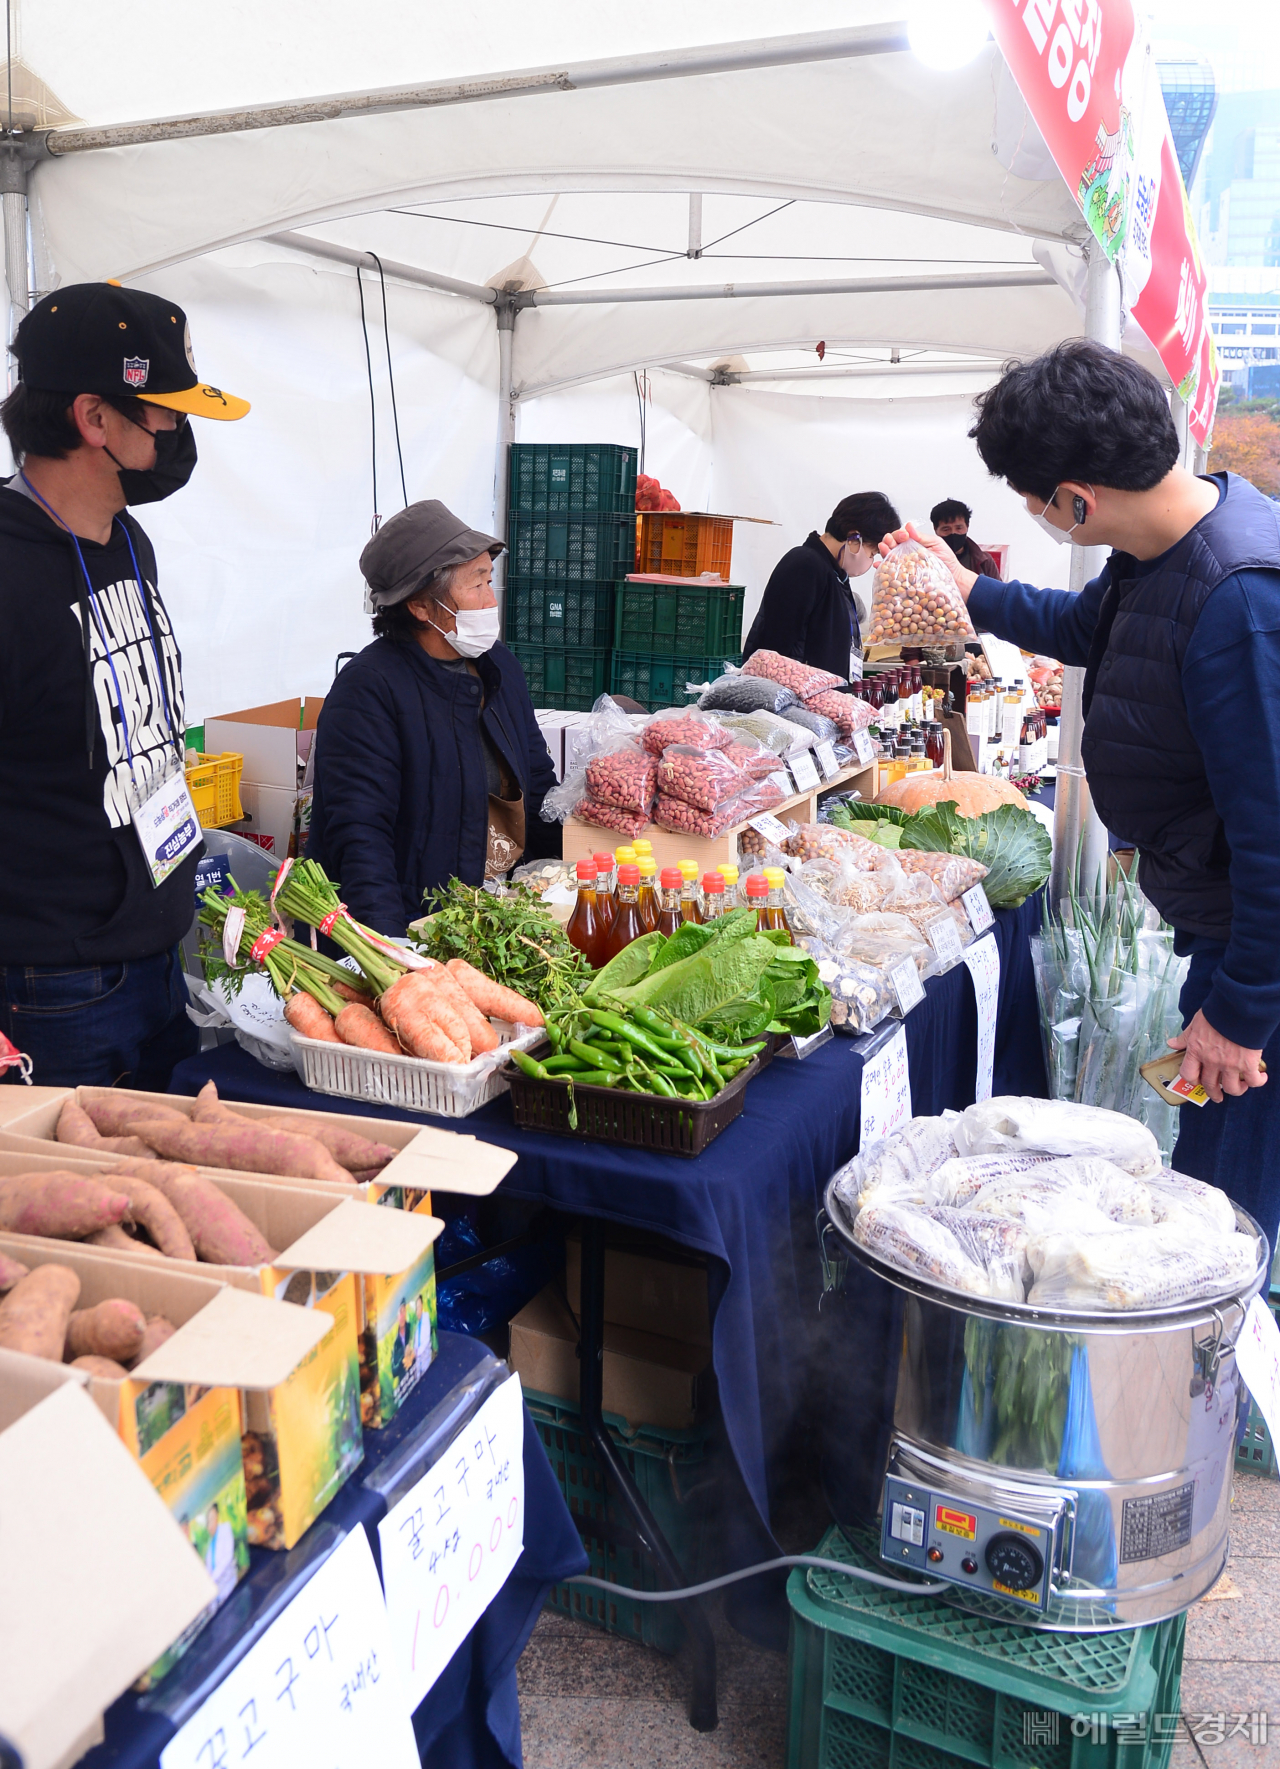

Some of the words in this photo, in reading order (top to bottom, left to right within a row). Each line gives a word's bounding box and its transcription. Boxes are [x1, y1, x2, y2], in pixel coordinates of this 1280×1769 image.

[126, 368, 145, 383] NFL
[164, 822, 194, 860] 진심농부
[863, 1115, 876, 1137] 당근
[940, 1523, 971, 1539] 품질보증
[340, 1648, 381, 1713] 국내산
